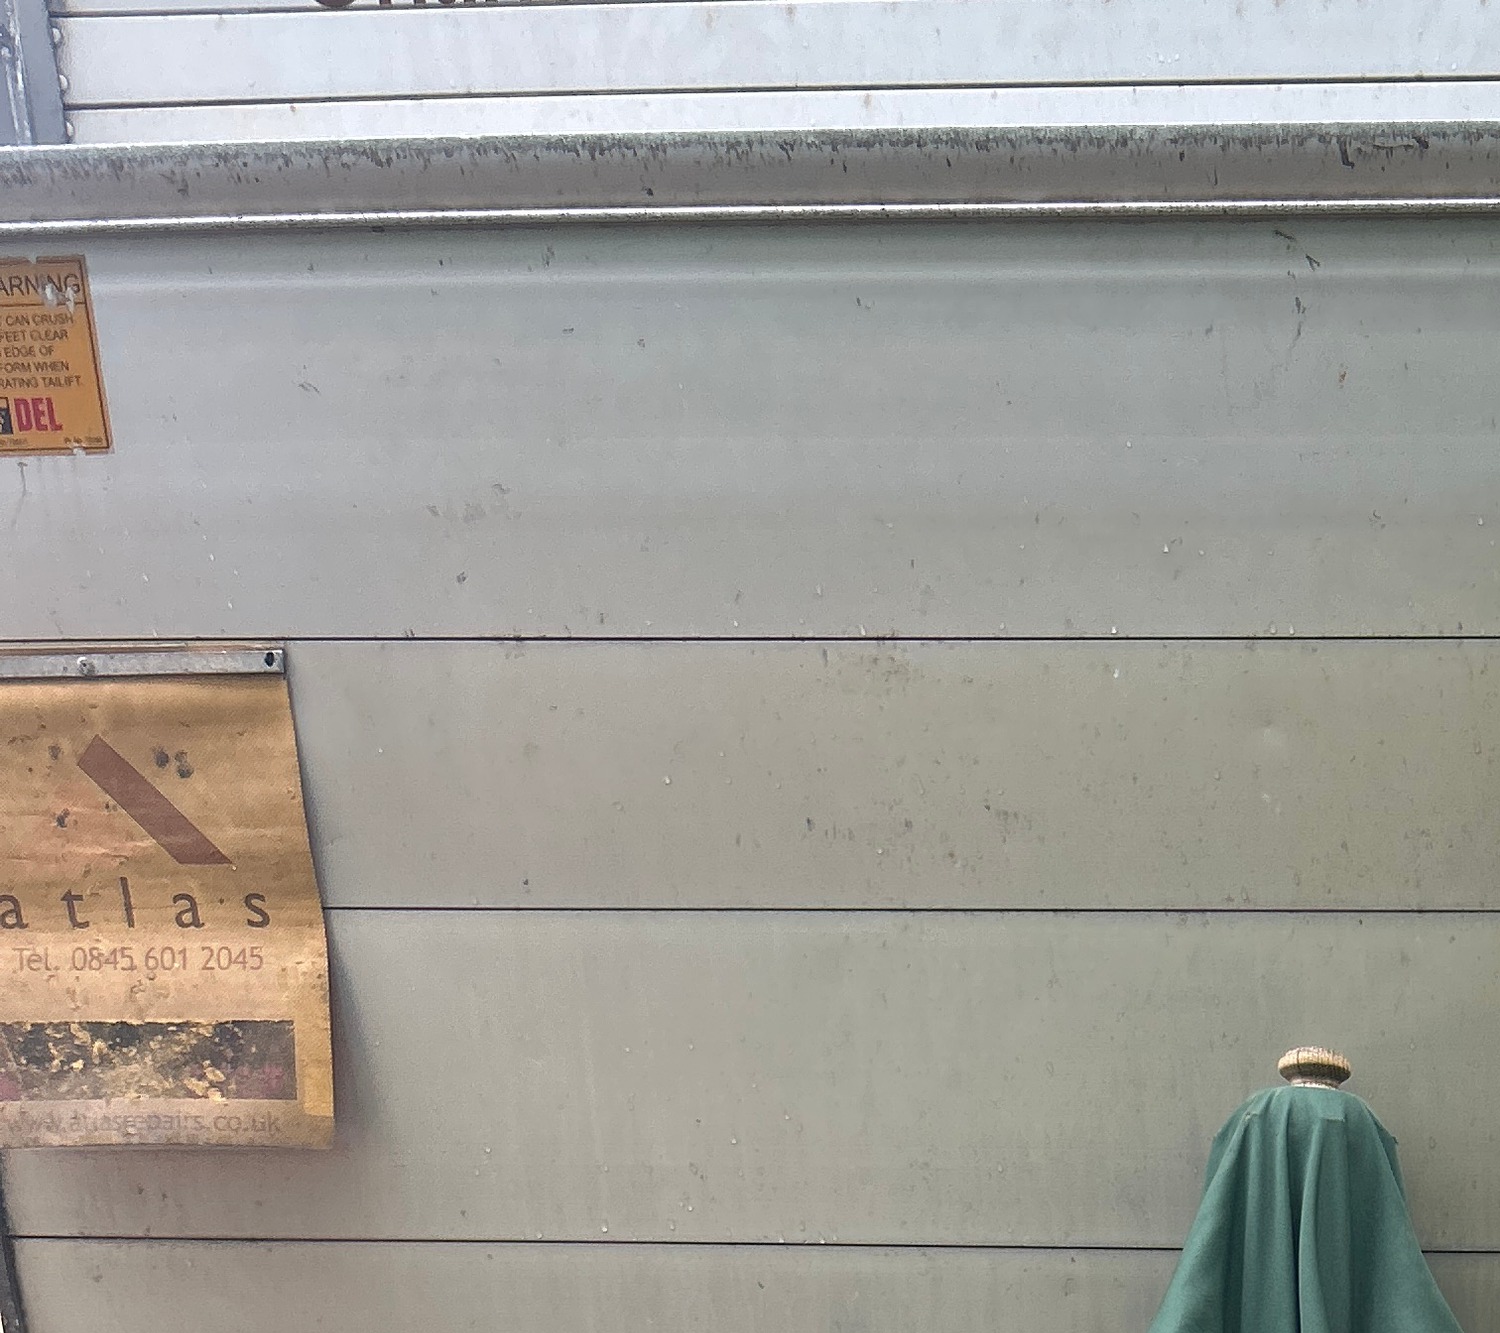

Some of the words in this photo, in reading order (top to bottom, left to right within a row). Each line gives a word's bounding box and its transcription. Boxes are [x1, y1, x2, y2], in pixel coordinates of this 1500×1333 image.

[5, 315, 30, 326] CAN
[32, 313, 74, 327] CRUSH
[30, 329, 68, 341] CLEAR
[4, 345, 36, 358] EDGE
[39, 345, 54, 356] OF
[33, 360, 69, 372] WHEN
[14, 397, 63, 433] DEL
[0, 877, 270, 929] atlas
[12, 946, 59, 972] Tel.
[71, 946, 136, 972] 0845
[144, 946, 188, 972] 601
[201, 945, 264, 971] 2045
